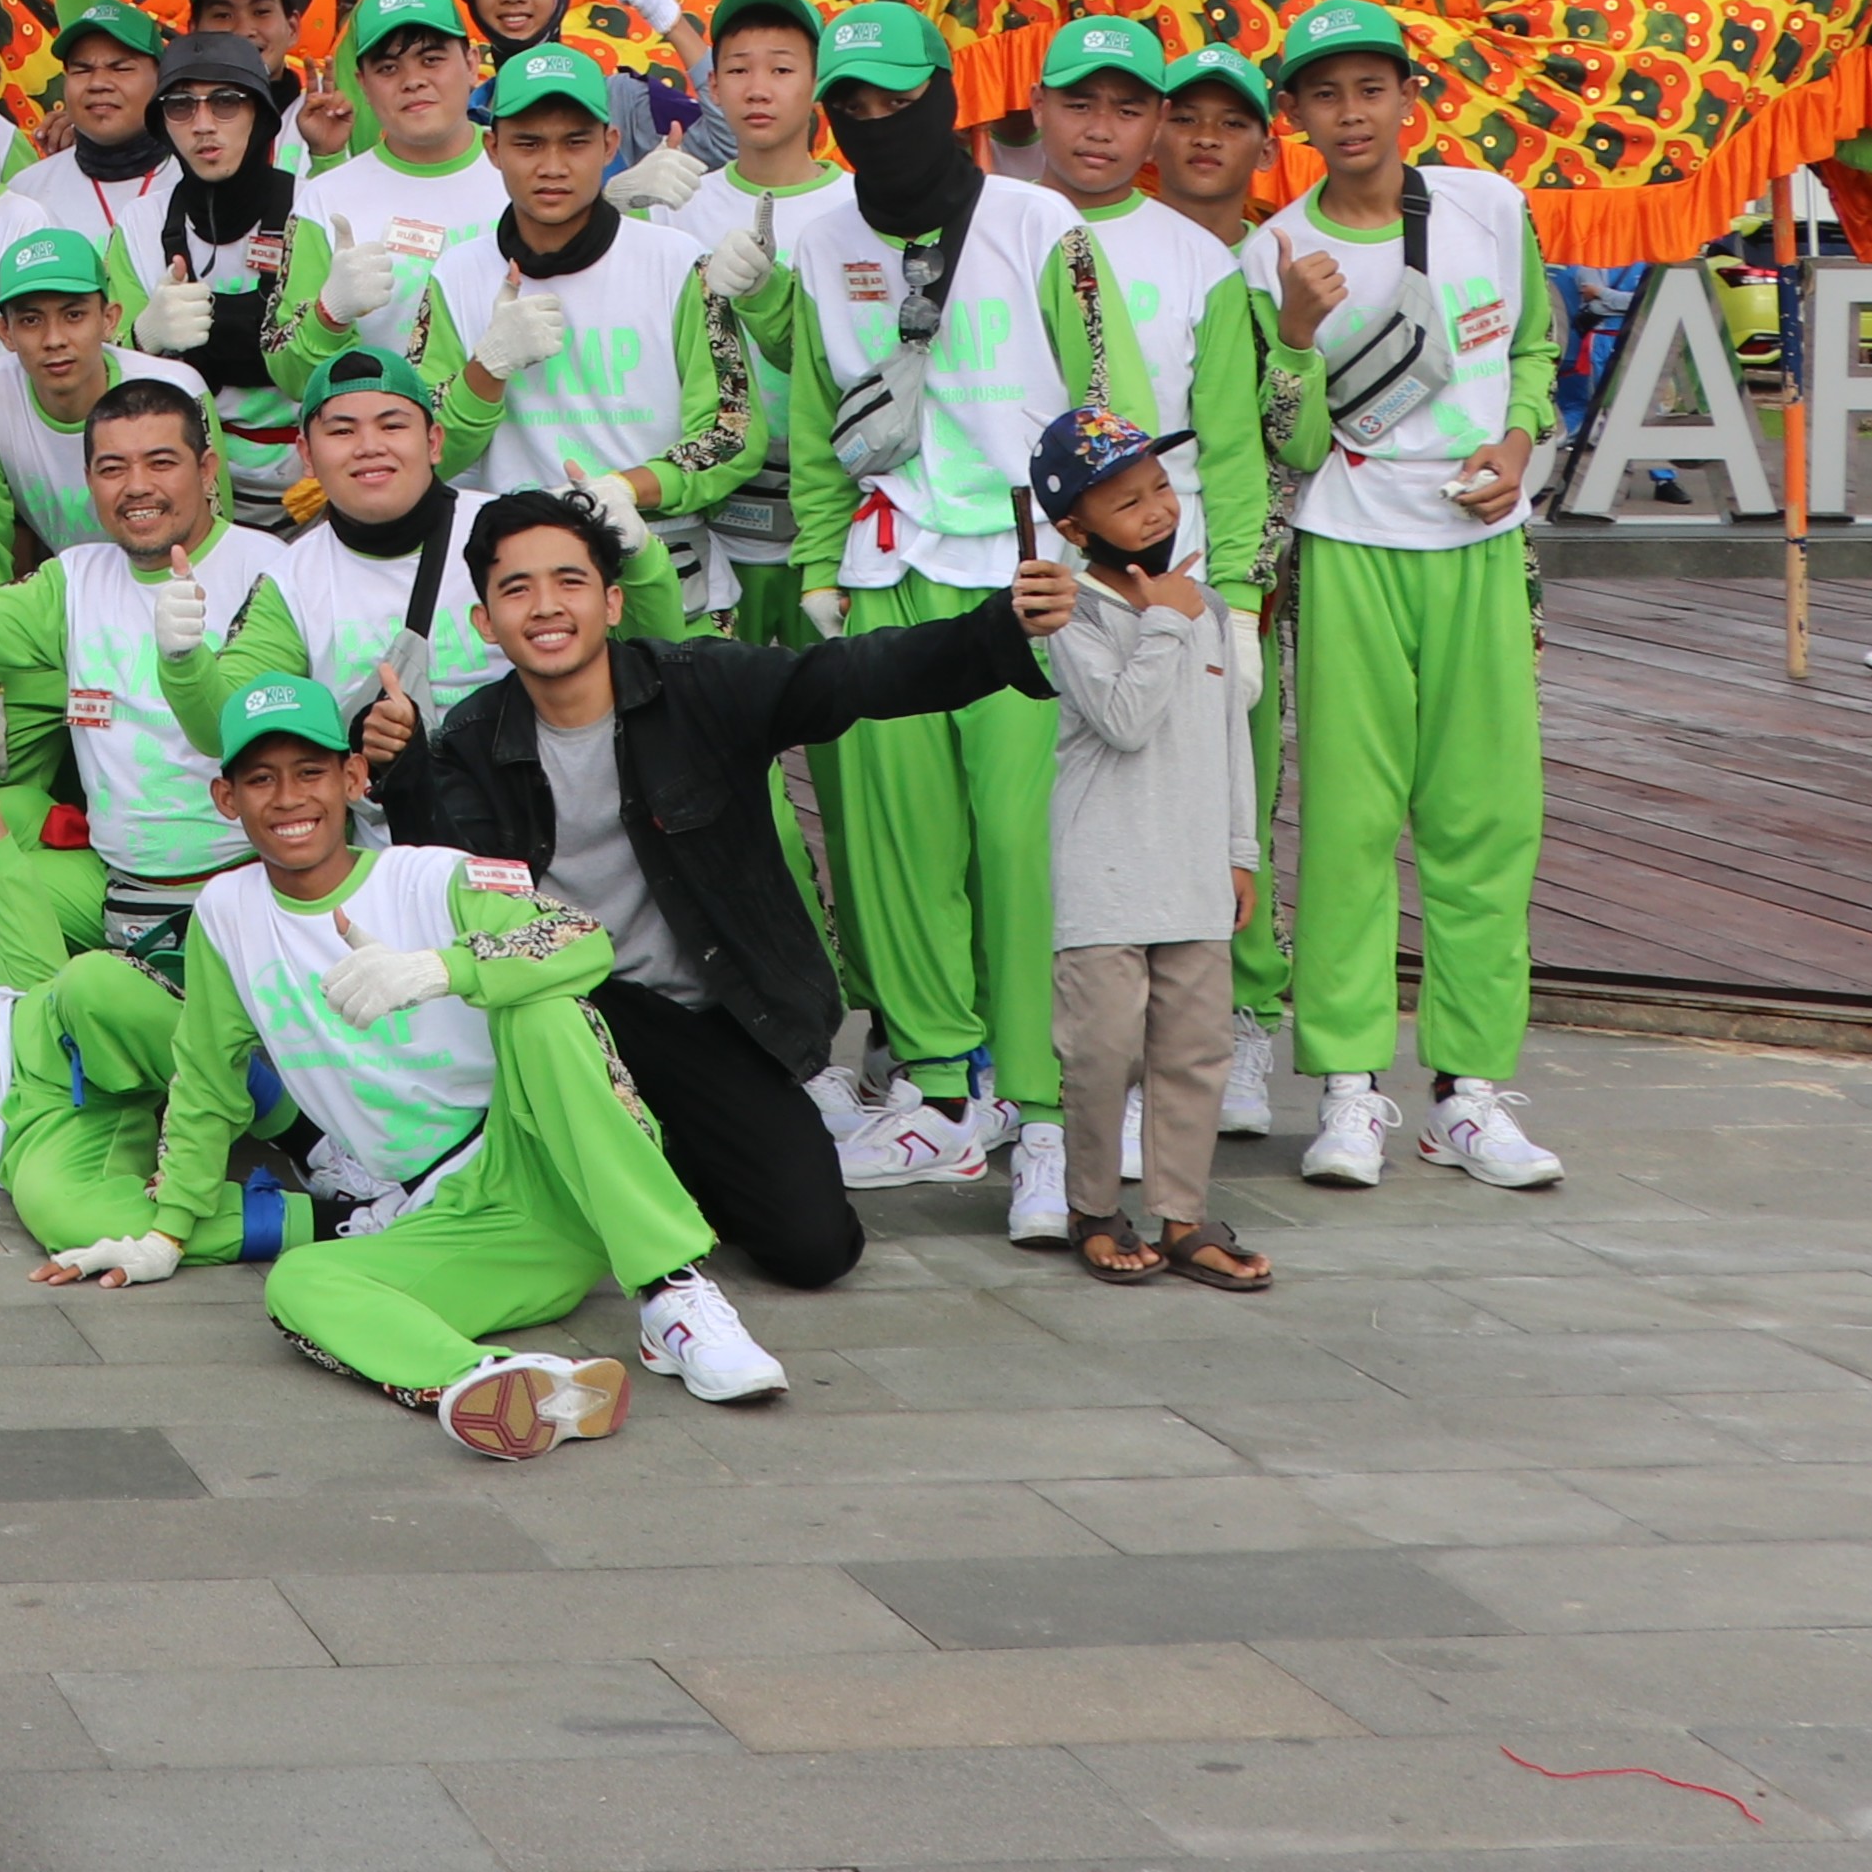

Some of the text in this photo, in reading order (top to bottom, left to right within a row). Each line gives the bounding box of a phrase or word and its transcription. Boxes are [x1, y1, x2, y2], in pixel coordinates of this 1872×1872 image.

[1327, 8, 1355, 28] KAP
[852, 22, 882, 41] KAP
[1104, 30, 1133, 50] KAP
[545, 55, 573, 72] KAP
[31, 240, 56, 258] KAP
[264, 685, 297, 705] KAP
